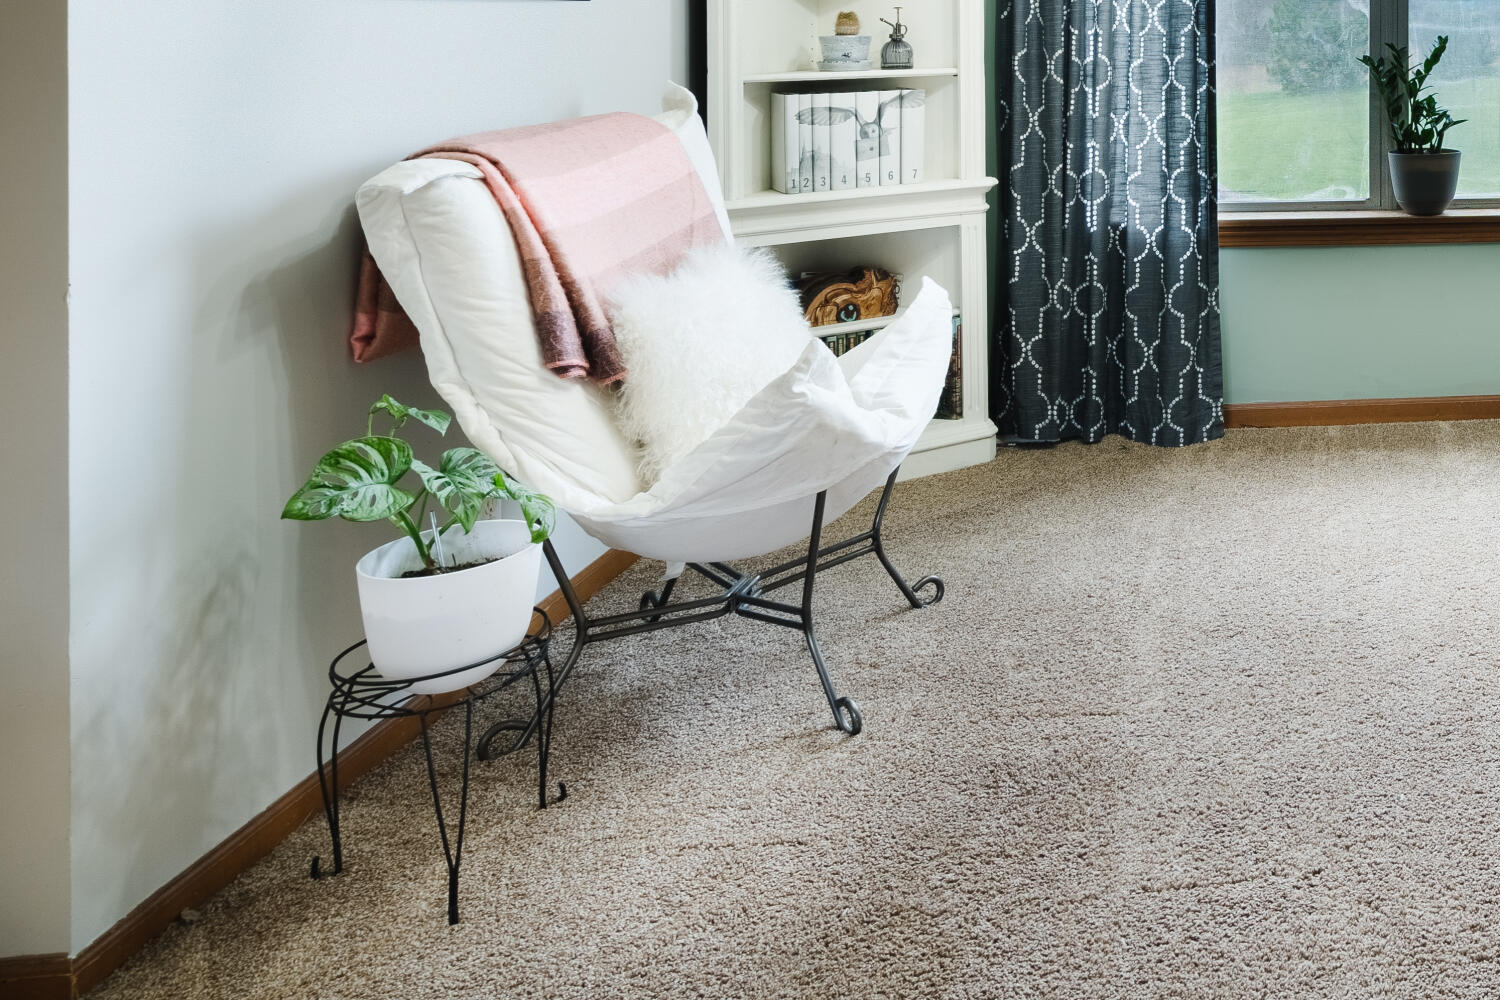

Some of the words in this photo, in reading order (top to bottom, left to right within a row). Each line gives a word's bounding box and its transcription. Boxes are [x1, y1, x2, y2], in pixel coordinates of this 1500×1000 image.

[865, 173, 871, 183] 5
[888, 170, 894, 180] 6
[913, 168, 918, 179] 7
[791, 179, 796, 189] 1
[803, 177, 809, 188] 2
[820, 177, 826, 187] 3
[841, 175, 847, 185] 4
